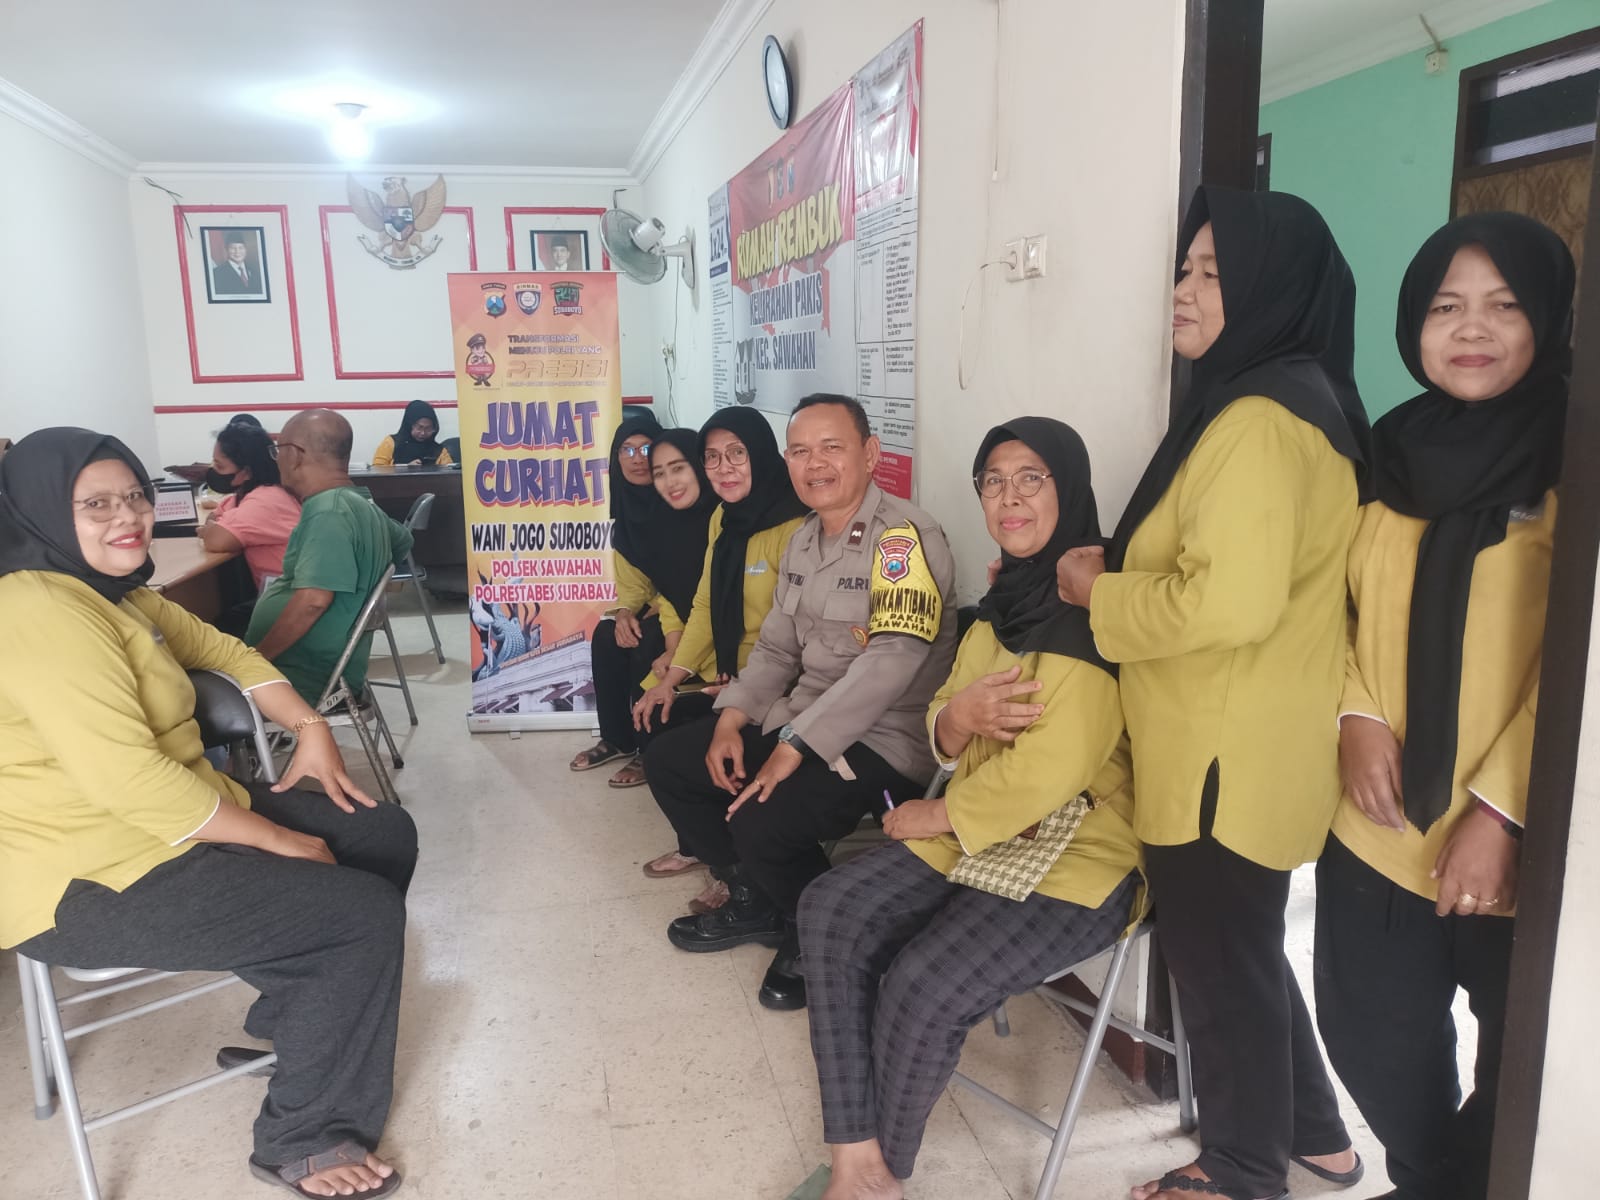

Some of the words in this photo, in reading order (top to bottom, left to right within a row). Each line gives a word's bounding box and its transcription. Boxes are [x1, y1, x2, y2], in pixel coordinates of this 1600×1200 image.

[737, 216, 775, 281] RUMAH
[777, 183, 842, 265] REMBUK
[750, 283, 794, 327] KELURAHAN
[794, 271, 823, 318] PAKIS
[755, 337, 773, 370] KEC.
[773, 331, 816, 370] SAWAHAN
[506, 359, 609, 378] PRESISI
[479, 400, 600, 450] JUMAT
[475, 456, 609, 508] CURHAT
[471, 522, 506, 551] WANI
[509, 522, 545, 551] JOGO
[492, 559, 538, 578] POLSEK
[541, 558, 602, 576] SAWAHAN
[475, 583, 555, 602] POLRESTABES
[558, 583, 618, 600] SURABAYA
[837, 577, 869, 590] POLRI
[877, 620, 931, 636] SAWAHAN
[889, 613, 926, 625] PAKIS
